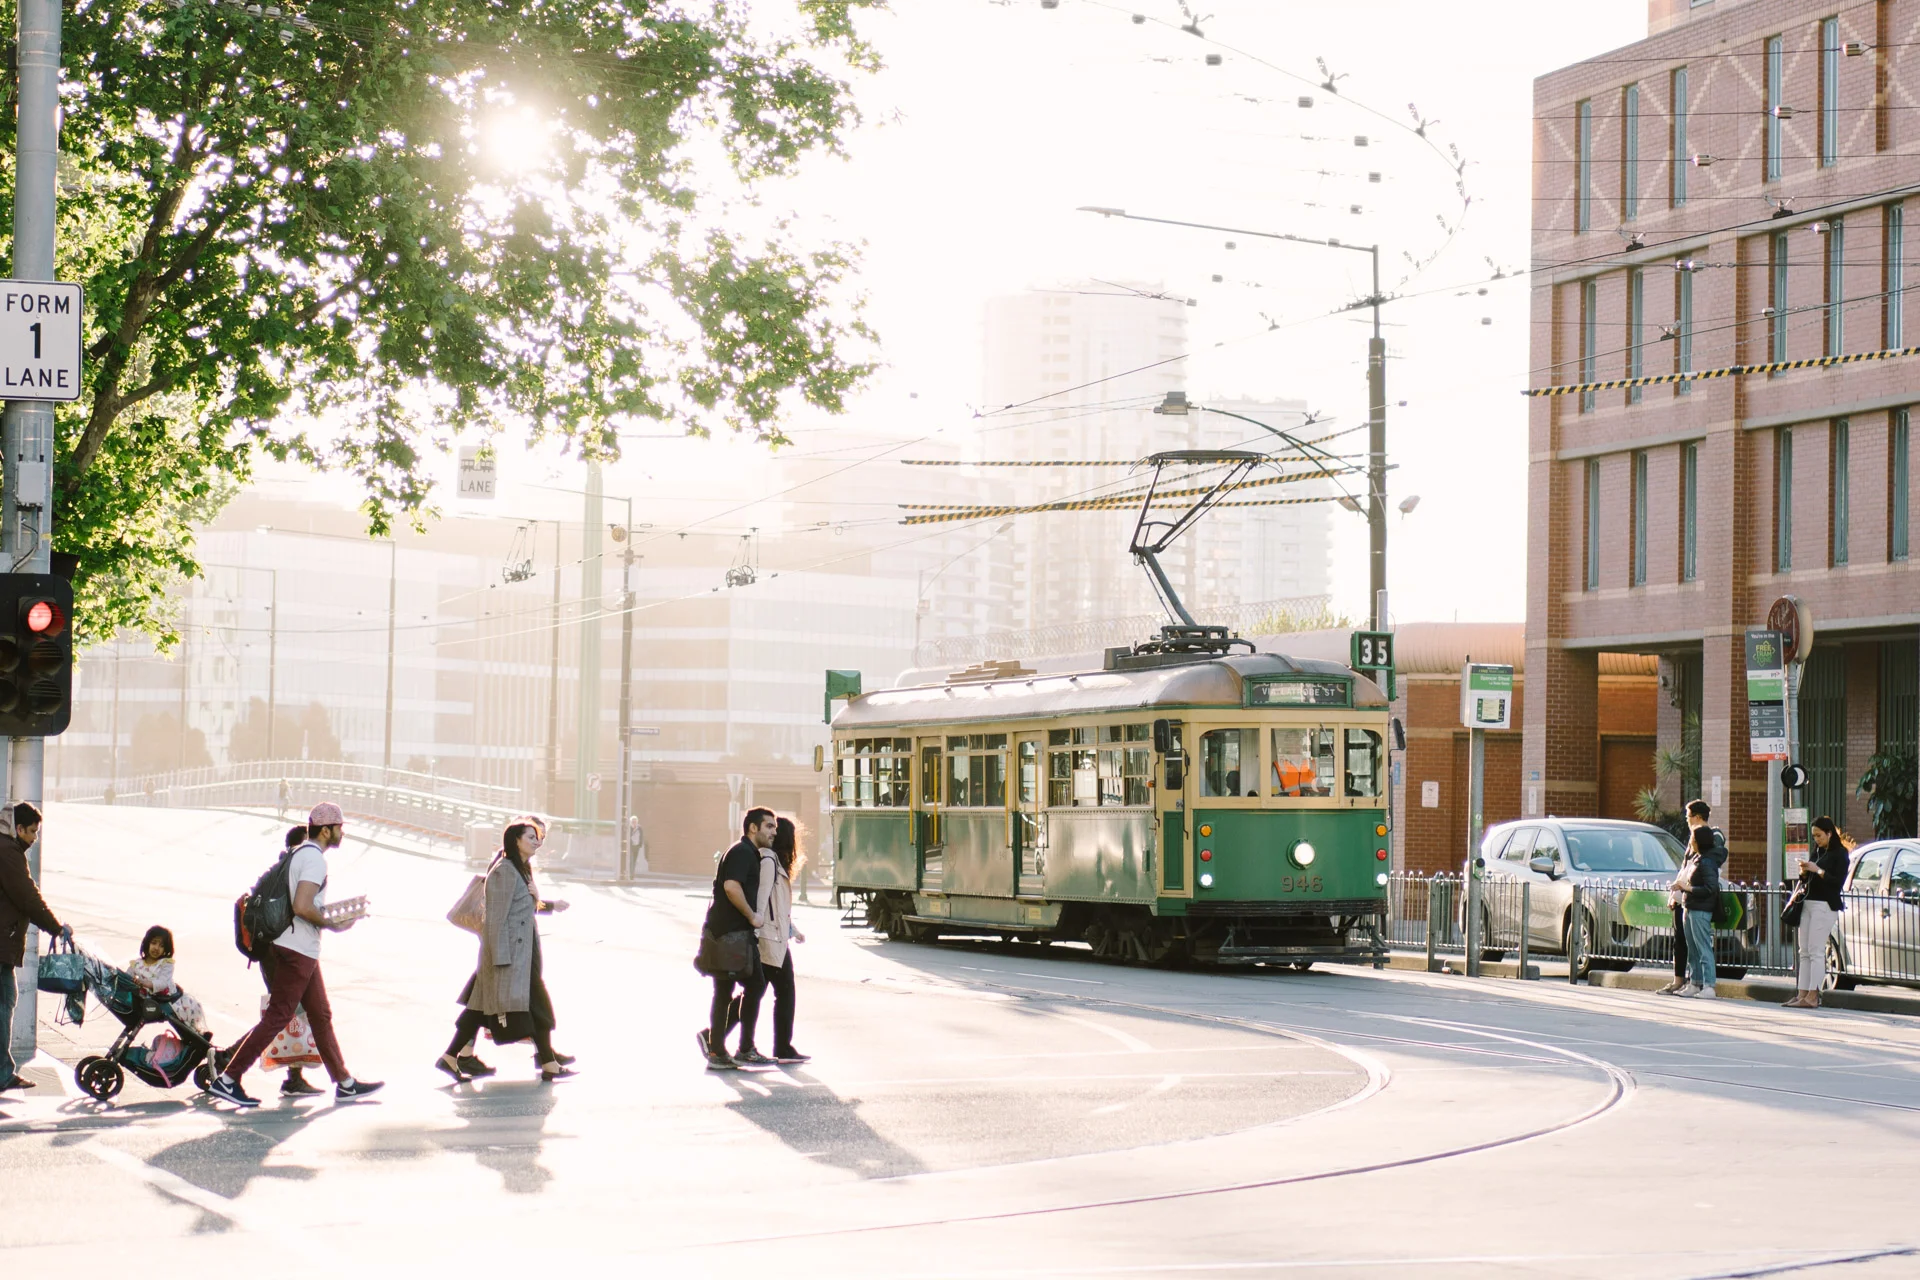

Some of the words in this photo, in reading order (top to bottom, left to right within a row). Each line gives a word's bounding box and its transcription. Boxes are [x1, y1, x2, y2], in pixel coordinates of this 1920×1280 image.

[6, 293, 70, 315] FORM
[29, 322, 41, 359] 1
[5, 367, 69, 388] LANE
[460, 479, 492, 493] LANE
[1361, 638, 1388, 665] 35
[1324, 688, 1336, 697] ST
[1750, 708, 1759, 716] 30
[1750, 719, 1759, 727] 35
[1751, 729, 1760, 737] 86
[1768, 743, 1785, 752] 119
[1281, 875, 1324, 893] 946
